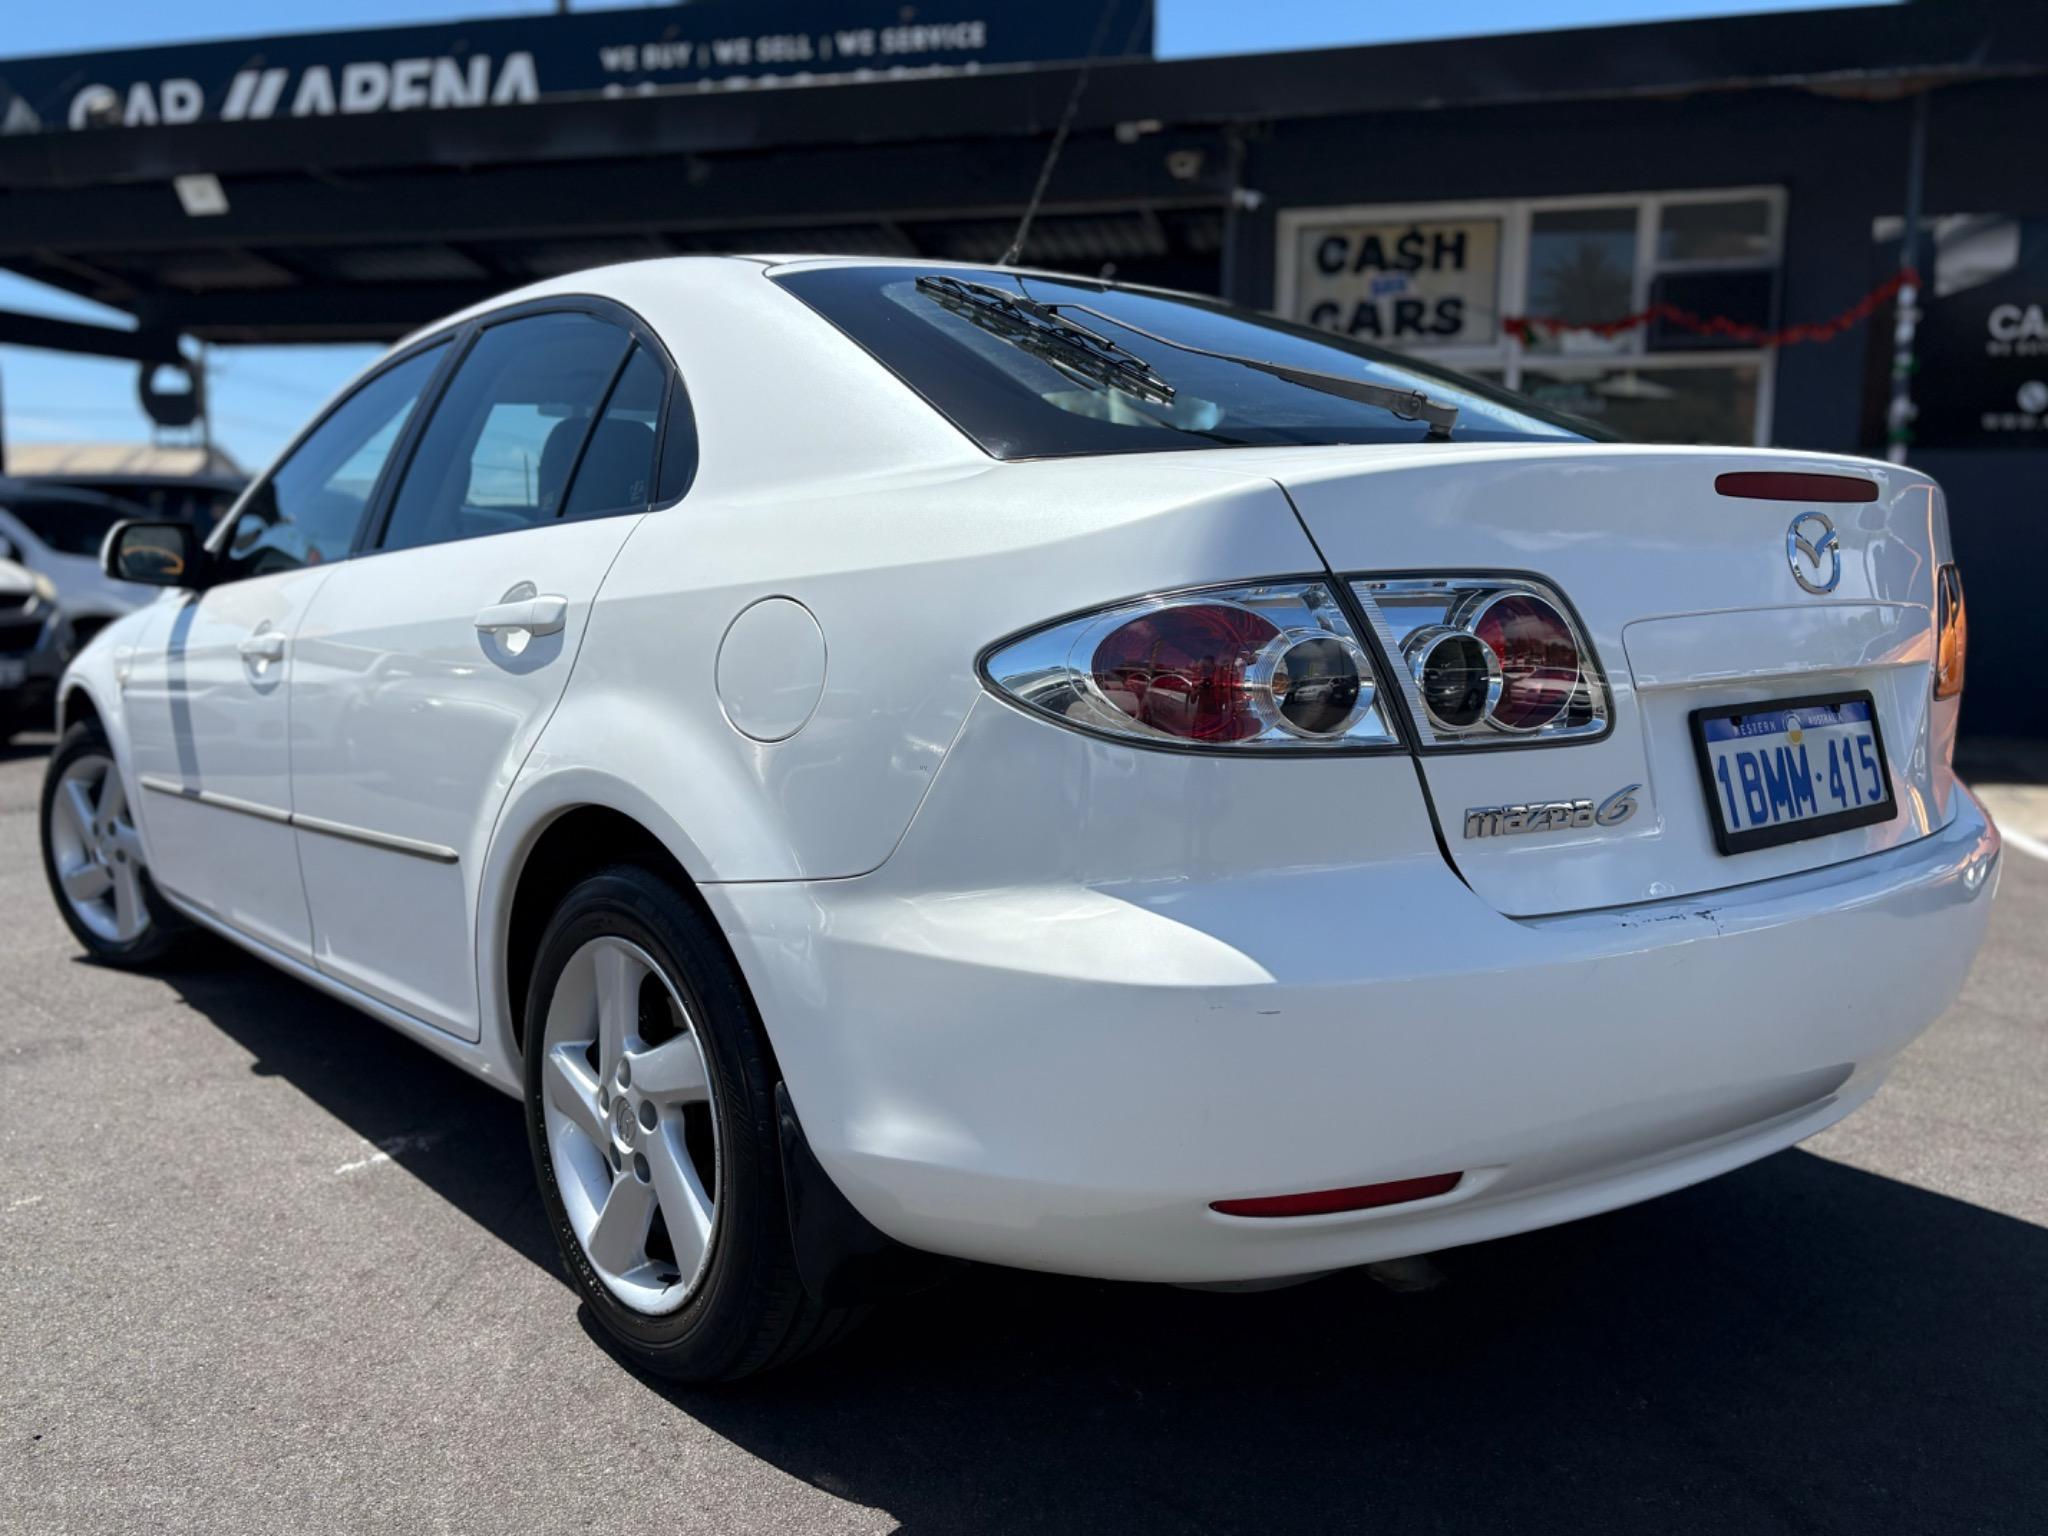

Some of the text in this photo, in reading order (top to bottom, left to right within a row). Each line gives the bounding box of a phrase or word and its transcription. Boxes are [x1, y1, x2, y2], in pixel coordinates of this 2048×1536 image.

[599, 20, 987, 73] WE BUY WE SELL WE SERVICE
[1309, 297, 1466, 337] CARS
